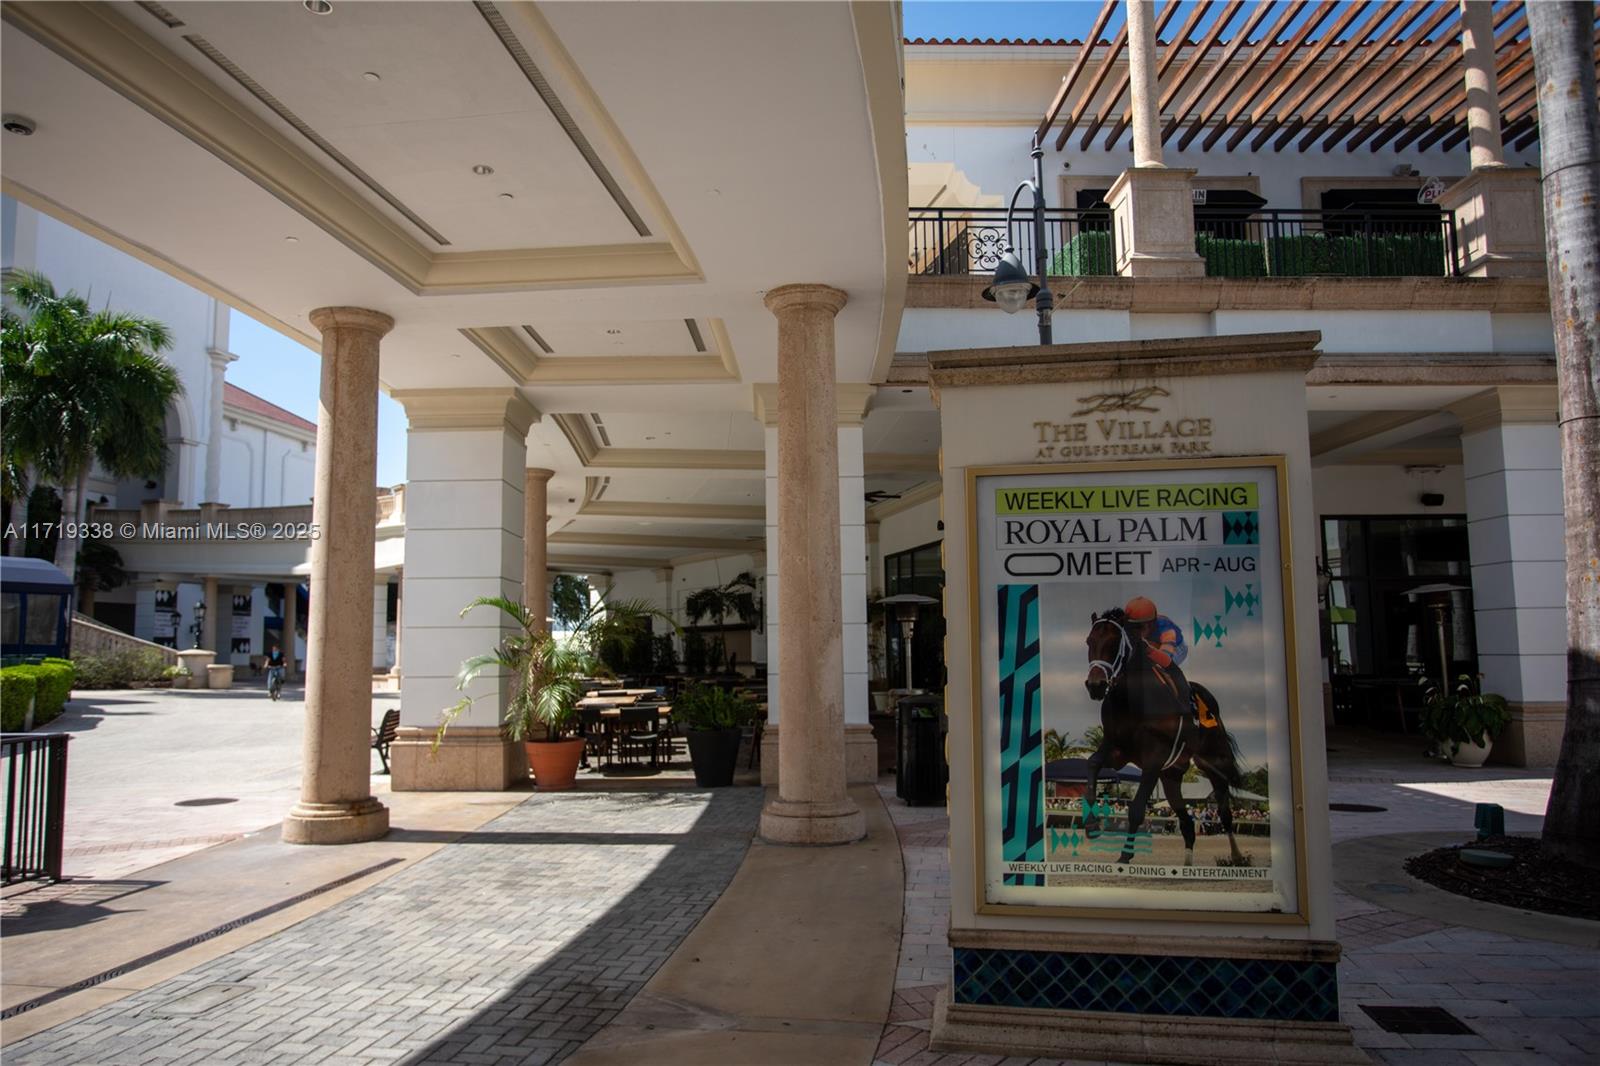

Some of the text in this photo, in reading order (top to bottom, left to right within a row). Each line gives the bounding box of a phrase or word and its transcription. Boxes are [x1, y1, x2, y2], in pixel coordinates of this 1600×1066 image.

[1033, 417, 1213, 443] THE VILLAGE
[1035, 441, 1212, 458] AT GULFSTREAM PARK
[1004, 487, 1249, 511] WEEKLY LIVE RACING
[1004, 515, 1207, 546] ROYAL PALM
[1008, 863, 1268, 878] WEEKLY LIVE RACING DINING ENTERTAINMENT
